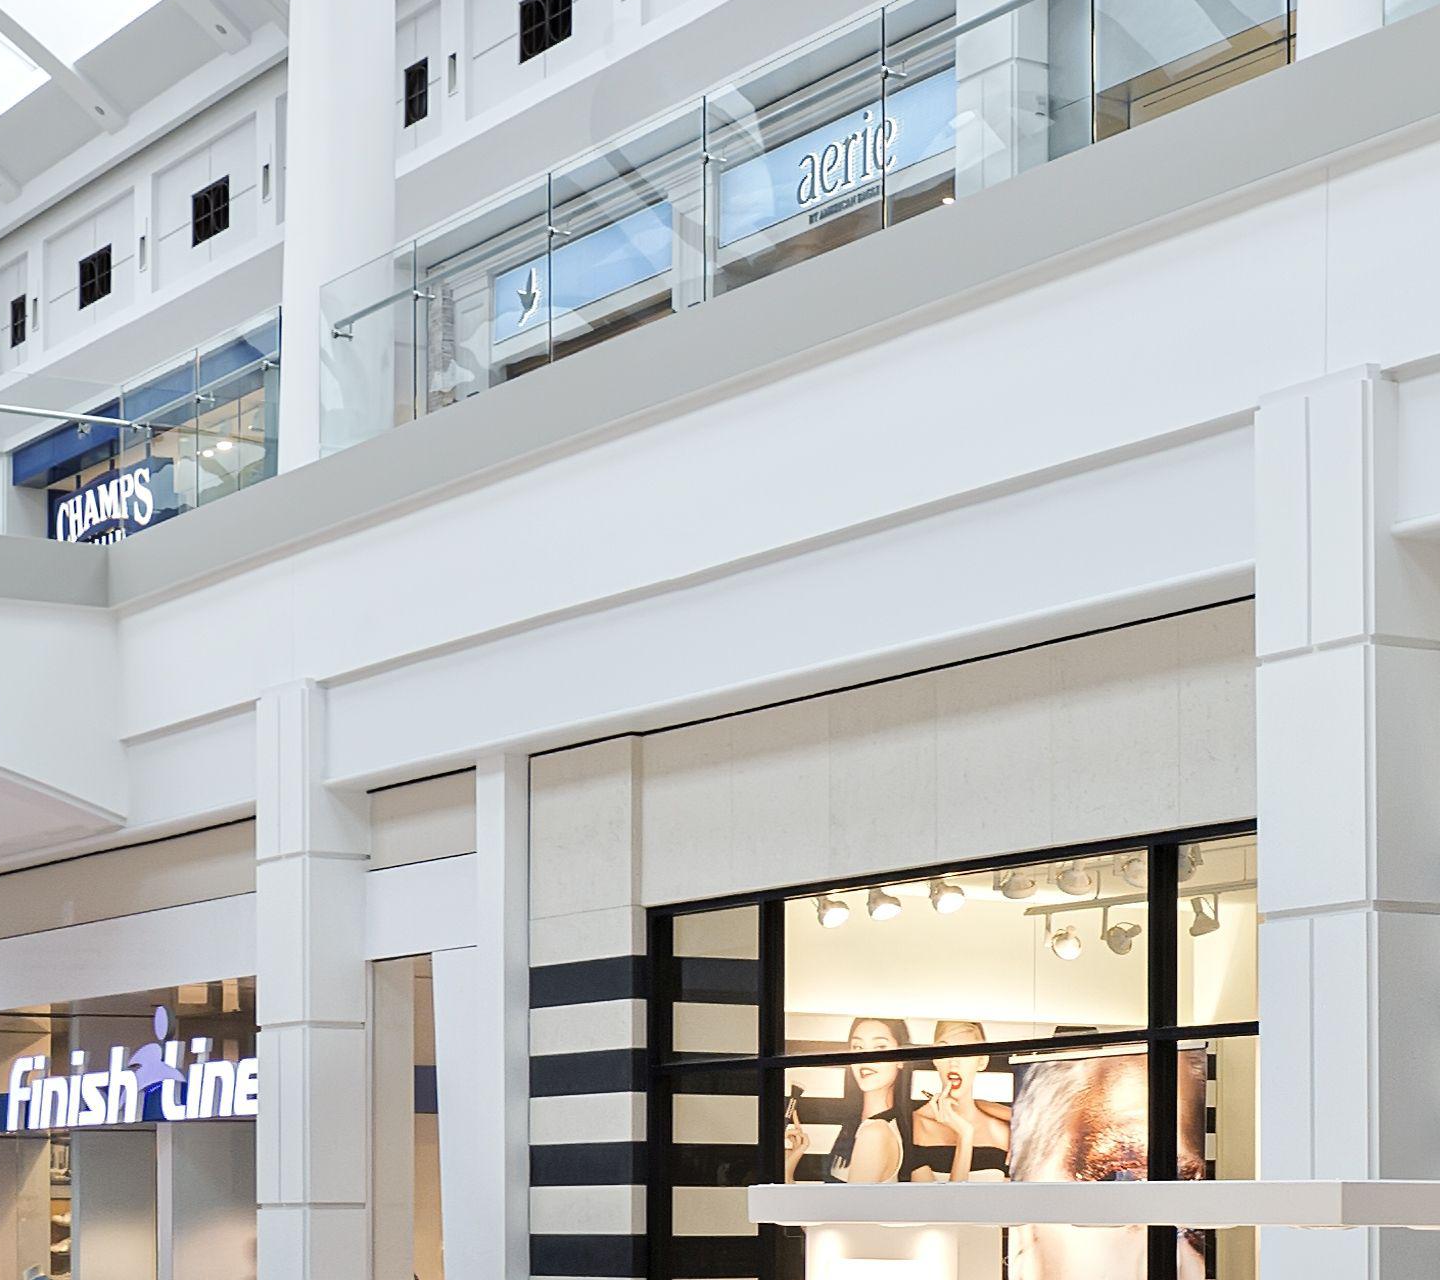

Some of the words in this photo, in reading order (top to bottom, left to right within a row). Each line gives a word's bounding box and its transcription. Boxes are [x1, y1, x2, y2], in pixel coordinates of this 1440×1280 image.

[797, 110, 897, 208] aerie
[56, 467, 154, 543] CHAMPS
[7, 1046, 139, 1131] Finish
